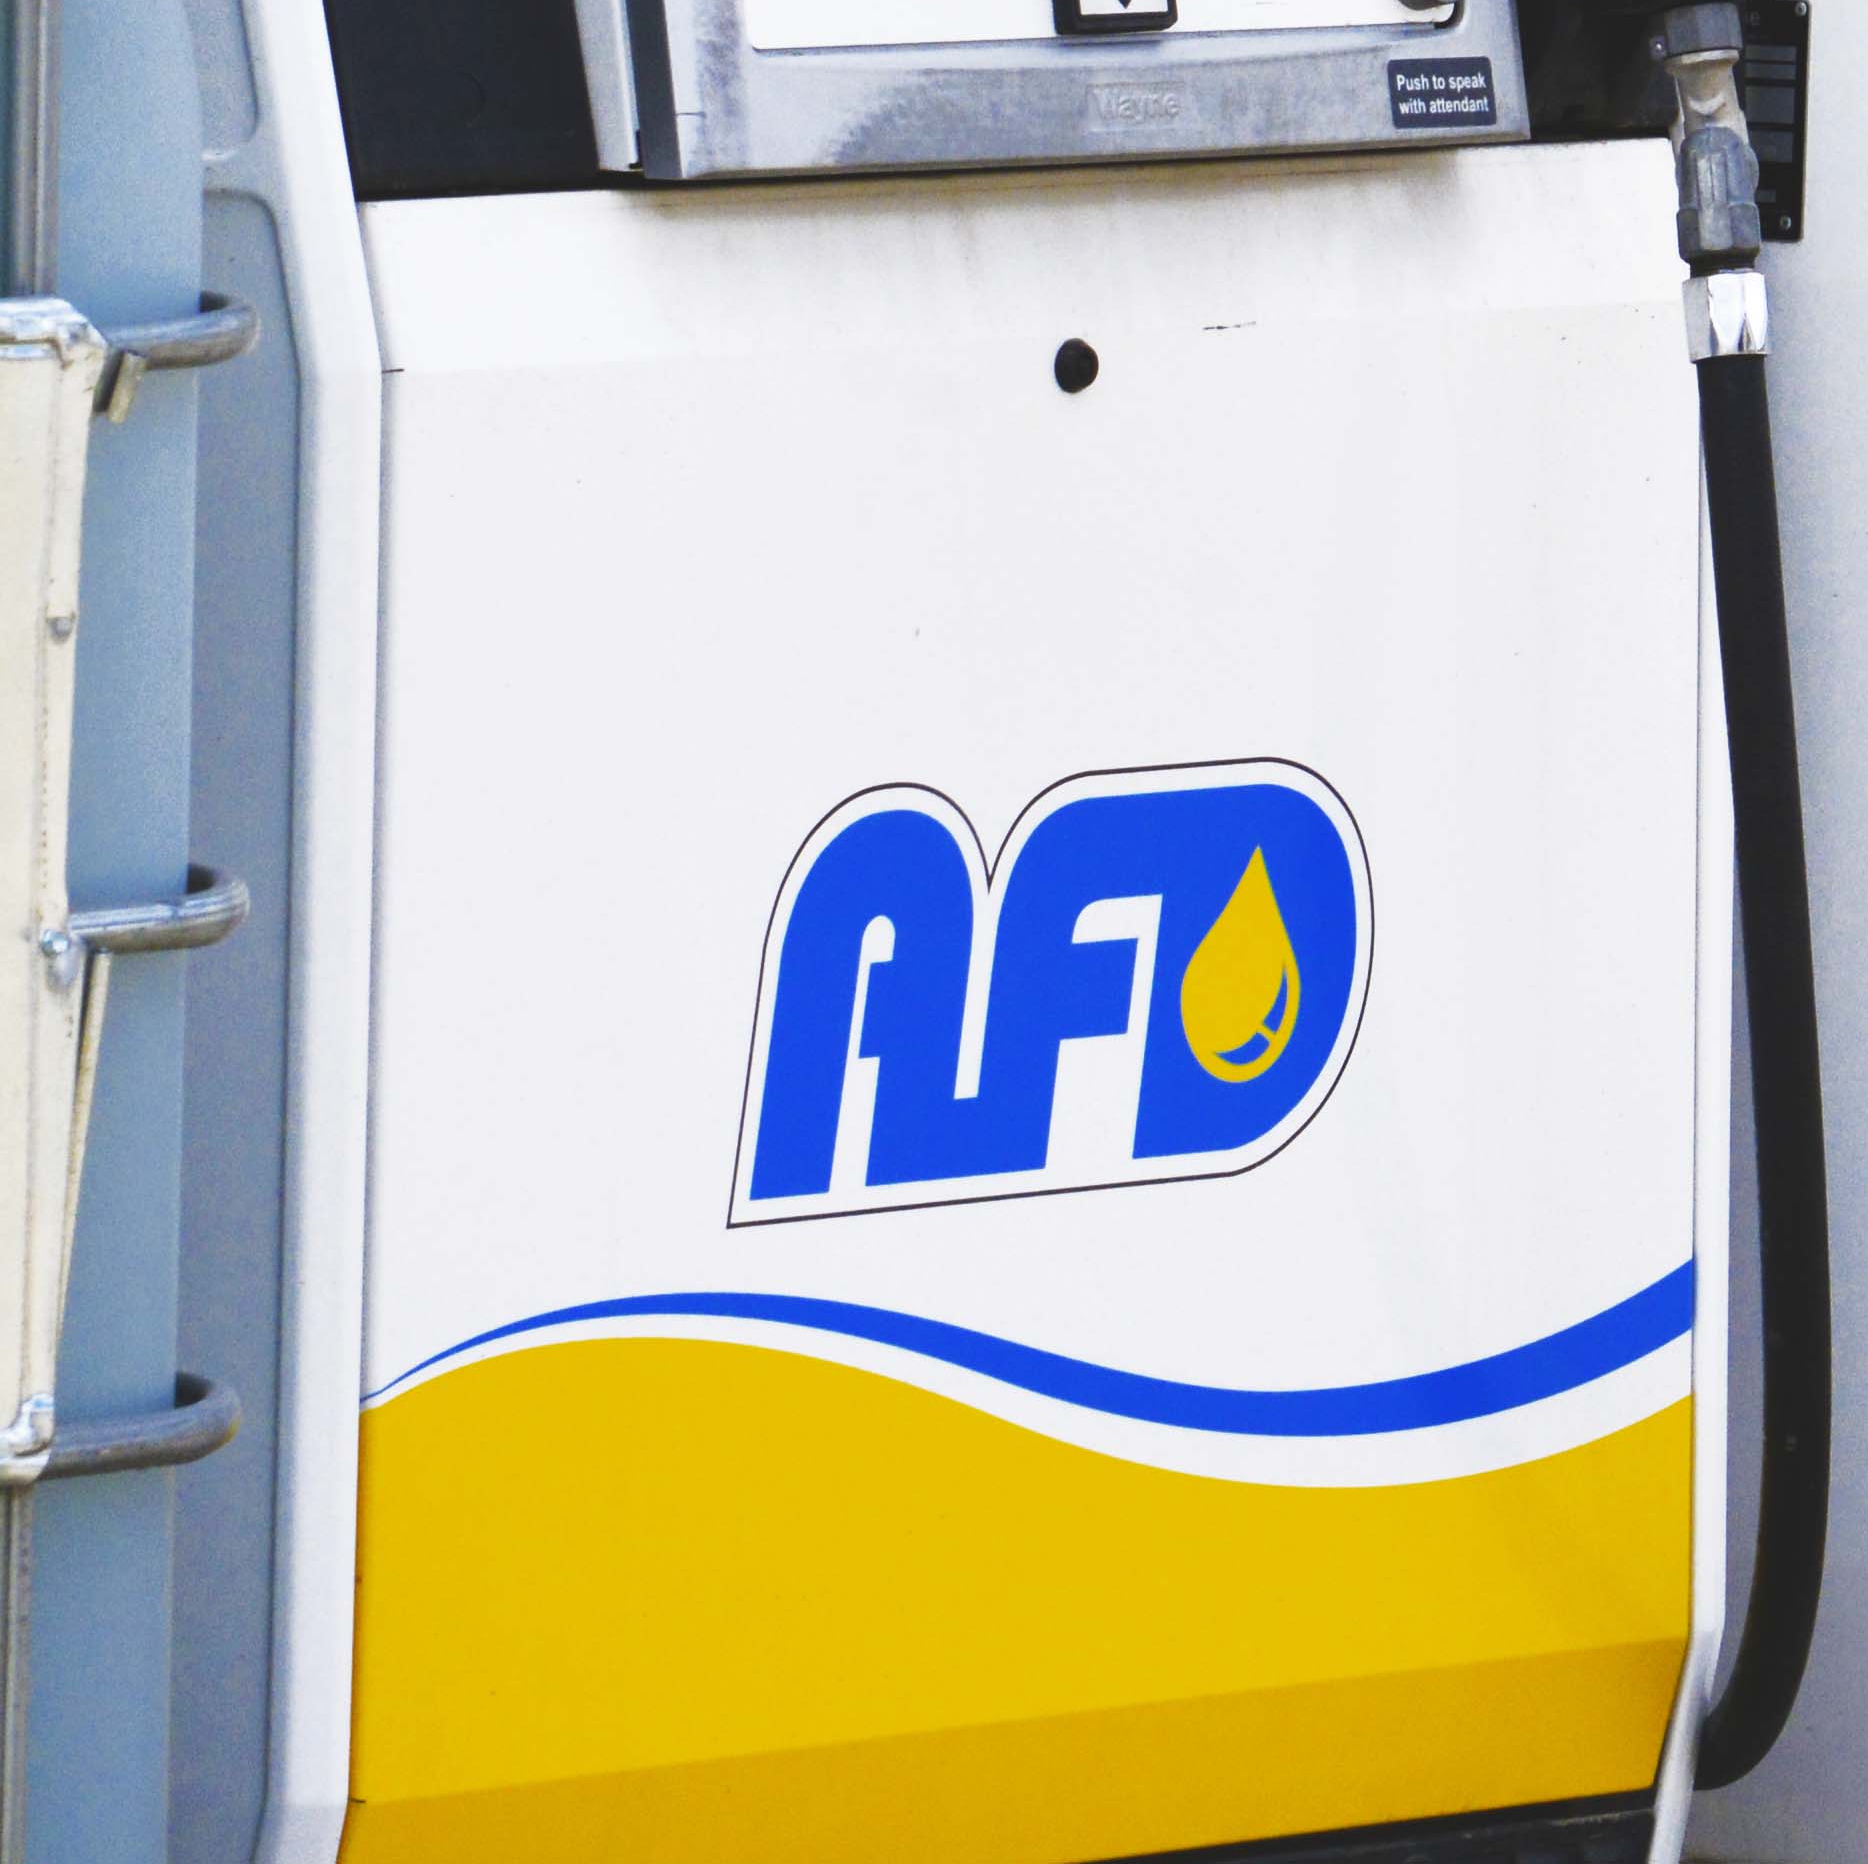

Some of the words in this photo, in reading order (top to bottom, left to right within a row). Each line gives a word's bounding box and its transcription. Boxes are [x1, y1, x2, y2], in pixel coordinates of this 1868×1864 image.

[1396, 73, 1430, 91] Push
[1432, 74, 1446, 90] to
[1448, 72, 1487, 93] speak
[1398, 97, 1426, 115] with
[1429, 96, 1490, 114] attendant
